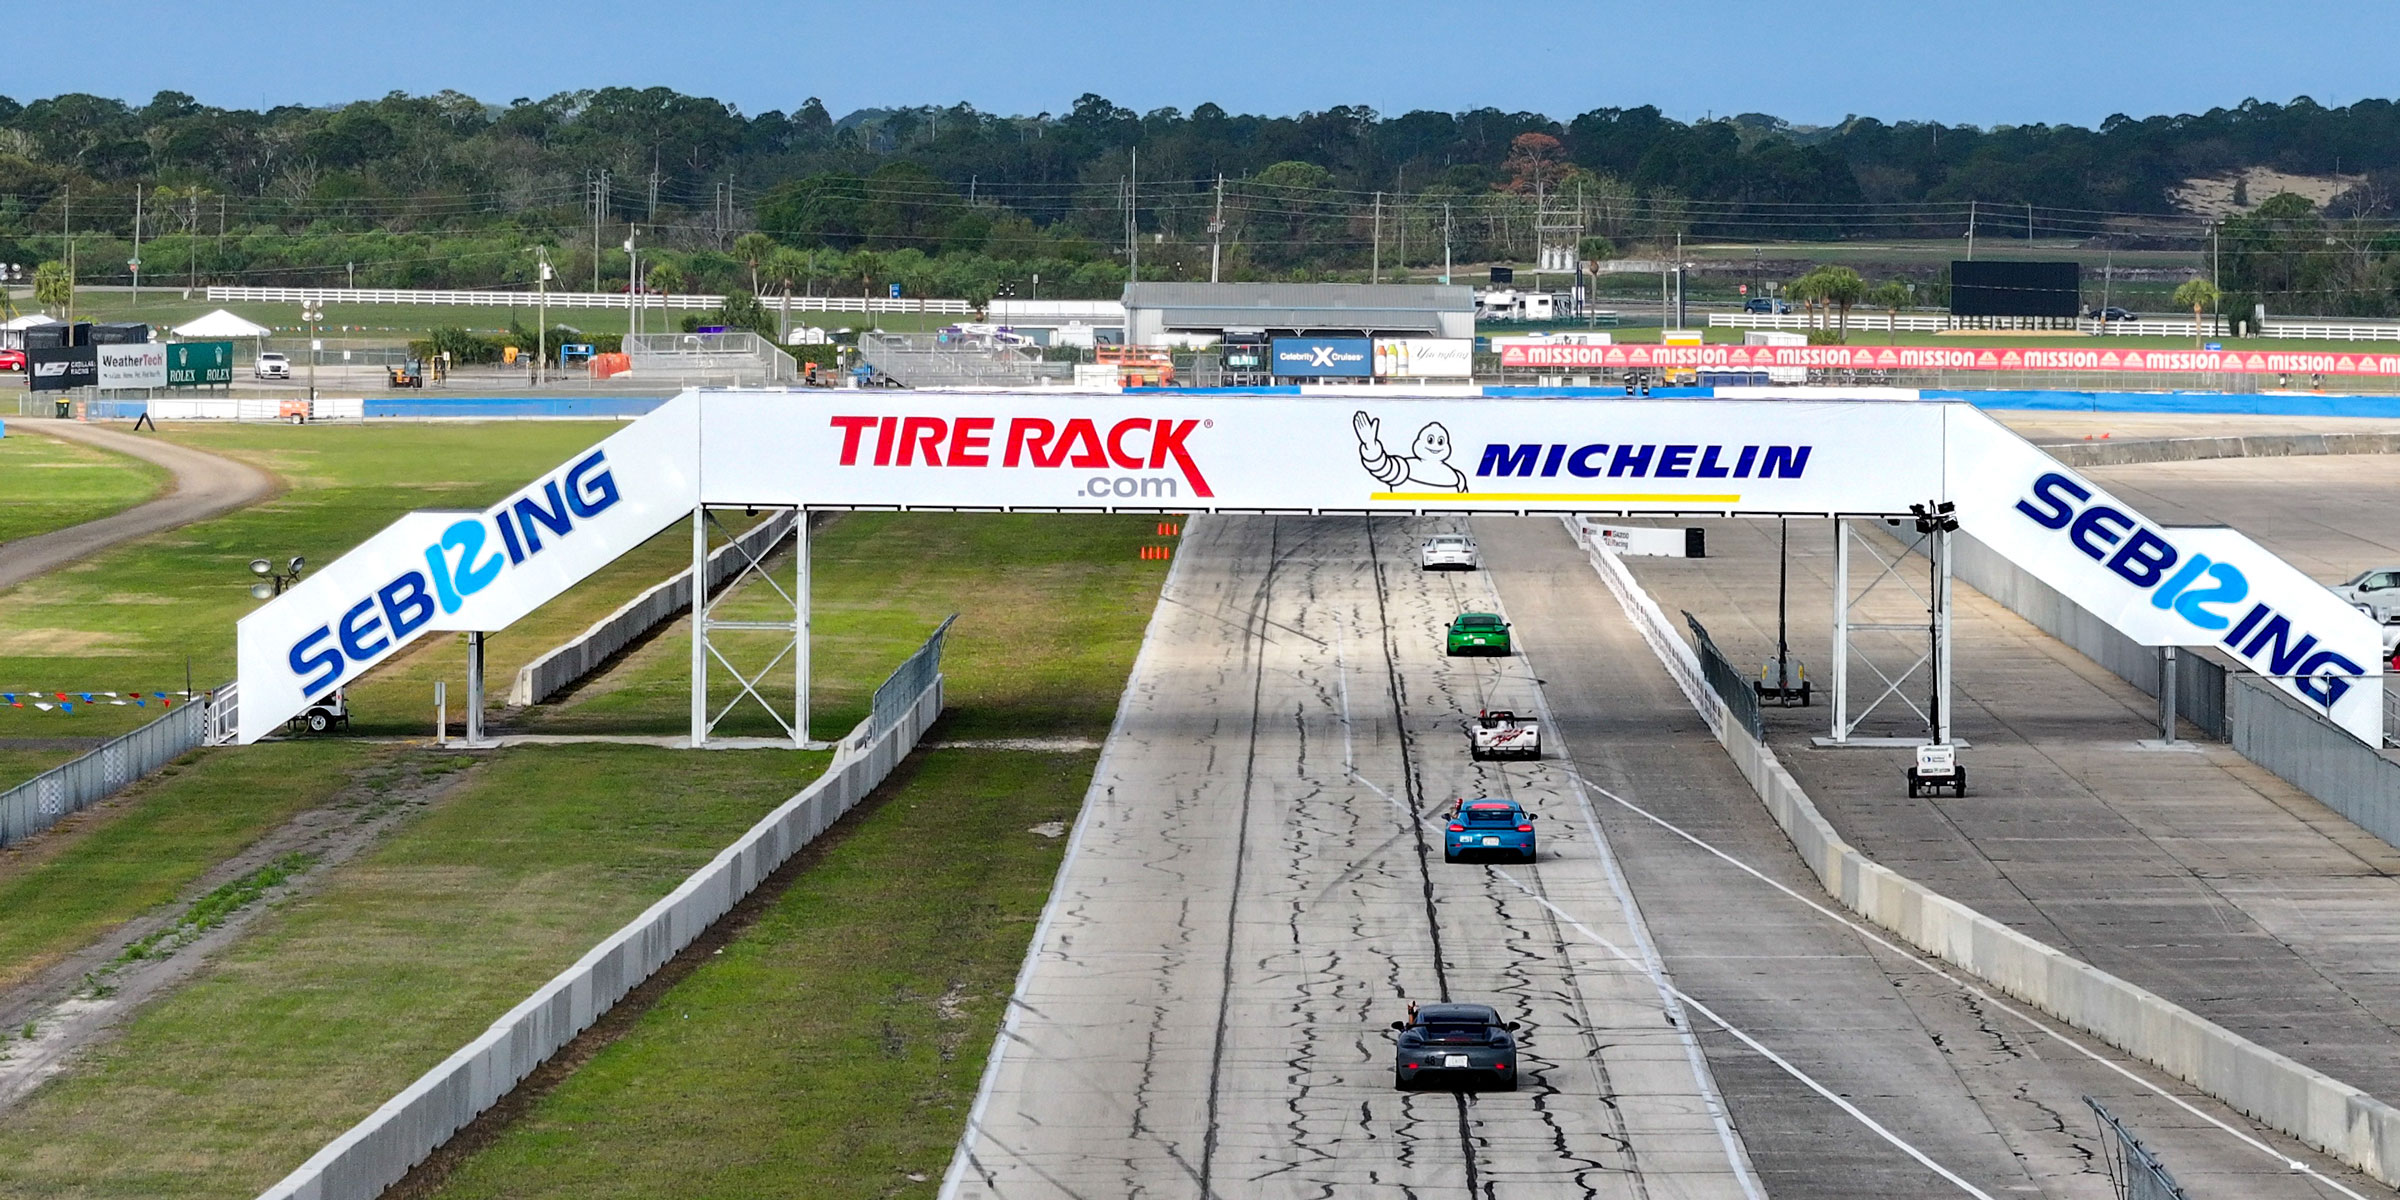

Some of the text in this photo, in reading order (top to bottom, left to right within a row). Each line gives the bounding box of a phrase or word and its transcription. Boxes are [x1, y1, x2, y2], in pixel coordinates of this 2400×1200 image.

[102, 353, 163, 367] WeatherTech
[1280, 352, 1314, 362] Celebrity
[170, 370, 195, 382] ROLEX
[206, 368, 230, 380] ROLEX
[830, 416, 995, 467] TIRE
[1475, 444, 1811, 479] MICHELIN
[1078, 476, 1178, 498] .com
